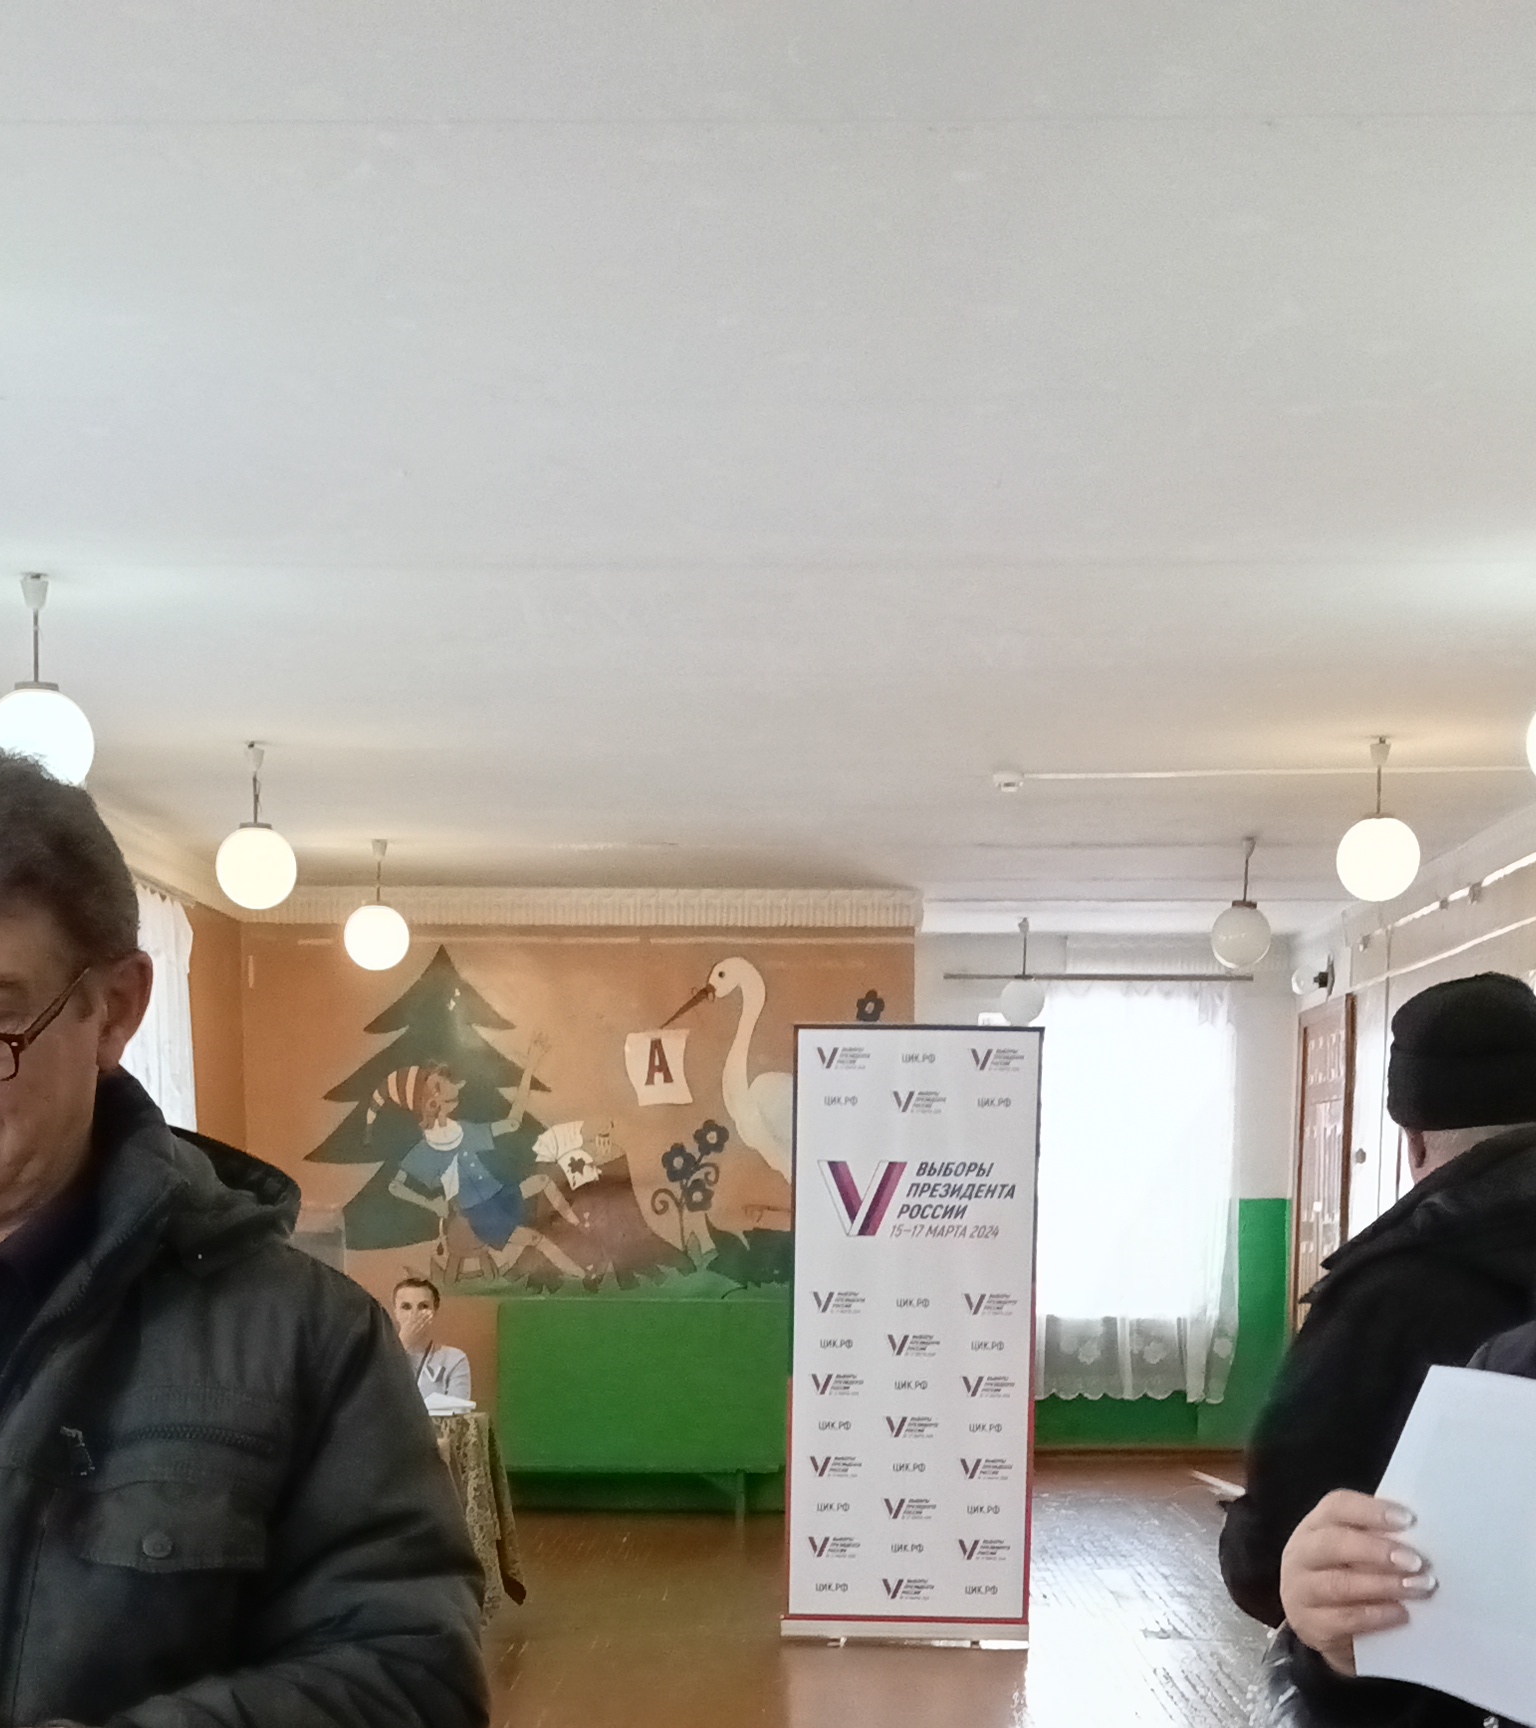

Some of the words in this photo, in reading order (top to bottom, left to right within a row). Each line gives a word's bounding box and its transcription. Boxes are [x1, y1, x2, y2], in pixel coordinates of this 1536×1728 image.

[902, 1053, 936, 1064] ЦИК.РФ
[824, 1096, 858, 1107] ЦИК.РФ
[977, 1097, 1012, 1108] ЦИК.РФ
[915, 1161, 995, 1178] ВЫБОРЫ
[906, 1183, 1016, 1200] ПРЕЗИДЕНТА
[897, 1203, 968, 1220] РОССИИ
[925, 1224, 967, 1239] МАРТА
[969, 1224, 1000, 1239] 2024
[896, 1297, 930, 1308] ЦИК.РФ
[820, 1339, 854, 1349] ЦИК.РФ
[971, 1341, 1005, 1351] ЦИК.РФ
[894, 1380, 928, 1391] ЦИК.РФ
[818, 1420, 852, 1431] ЦИК.РФ
[969, 1423, 1003, 1434] ЦИК.РФ
[892, 1463, 926, 1473] ЦИК.РФ
[817, 1502, 850, 1513] ЦИК.РФ
[967, 1505, 1001, 1515] ЦИК.РФ
[891, 1543, 924, 1554] ЦИК.РФ
[815, 1582, 849, 1593] ЦИК.РФ
[965, 1585, 999, 1595] ЦИК.РФ
